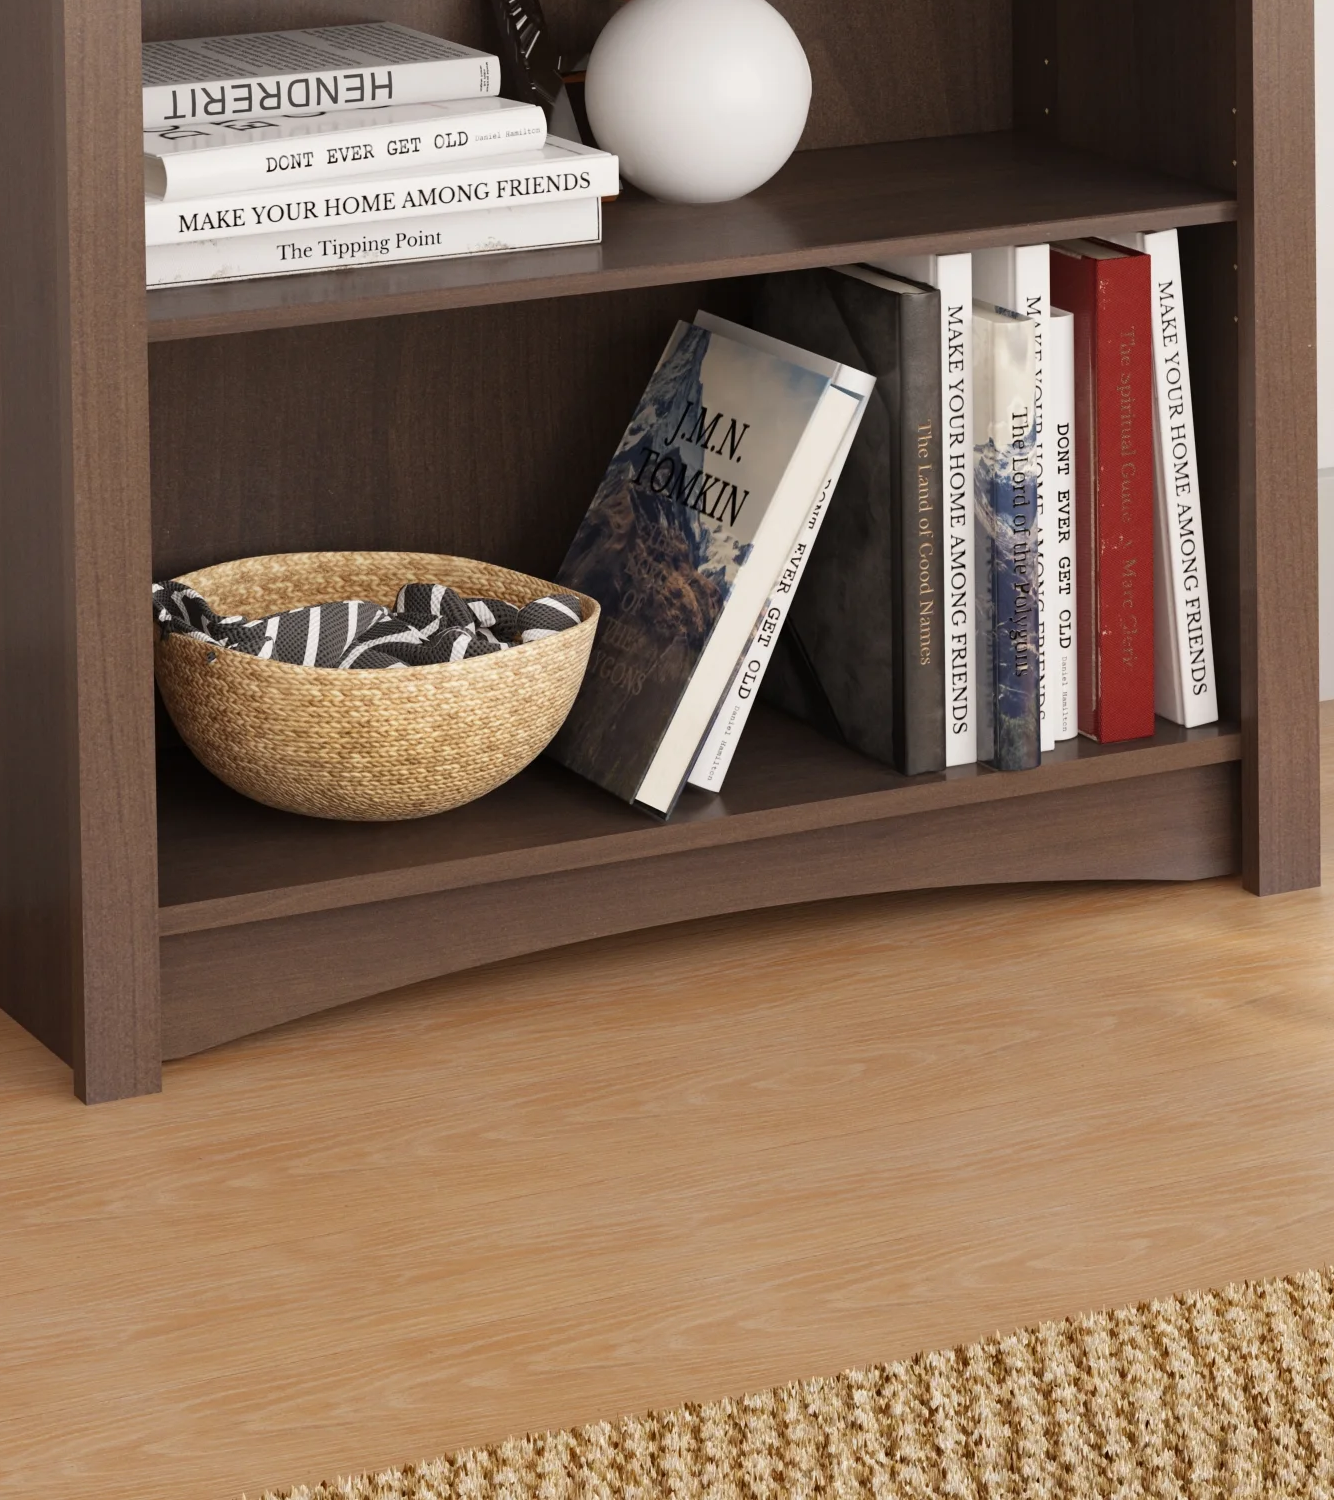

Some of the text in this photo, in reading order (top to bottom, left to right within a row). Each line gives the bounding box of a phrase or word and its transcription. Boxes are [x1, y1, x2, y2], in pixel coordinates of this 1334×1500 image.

[163, 71, 394, 120] HENDRERIT
[266, 127, 541, 172] DONT EVER GET OLD Daniel Hamilton
[178, 172, 591, 233] MAKE YOUR HOME AMONG FRIENDS
[277, 230, 443, 260] The Tipping Point
[664, 400, 751, 463] J.M.N.
[631, 447, 750, 527] TOMKIN
[1158, 280, 1207, 696] MAKE YOUR HOME AMONG FRIENDS
[917, 418, 935, 666] The Land of Good Names
[947, 305, 968, 735] MAKE YOUR HOME AMONG FRIENDS
[1009, 406, 1033, 678] The Lord of the Polygons
[777, 543, 807, 594] EVER
[1057, 422, 1072, 732] DONT EVER GET OLD Daniel Hamilton
[757, 607, 781, 648] GET
[738, 660, 761, 699] OLD
[725, 706, 741, 736] Daniel
[707, 741, 727, 781] Hamilton
